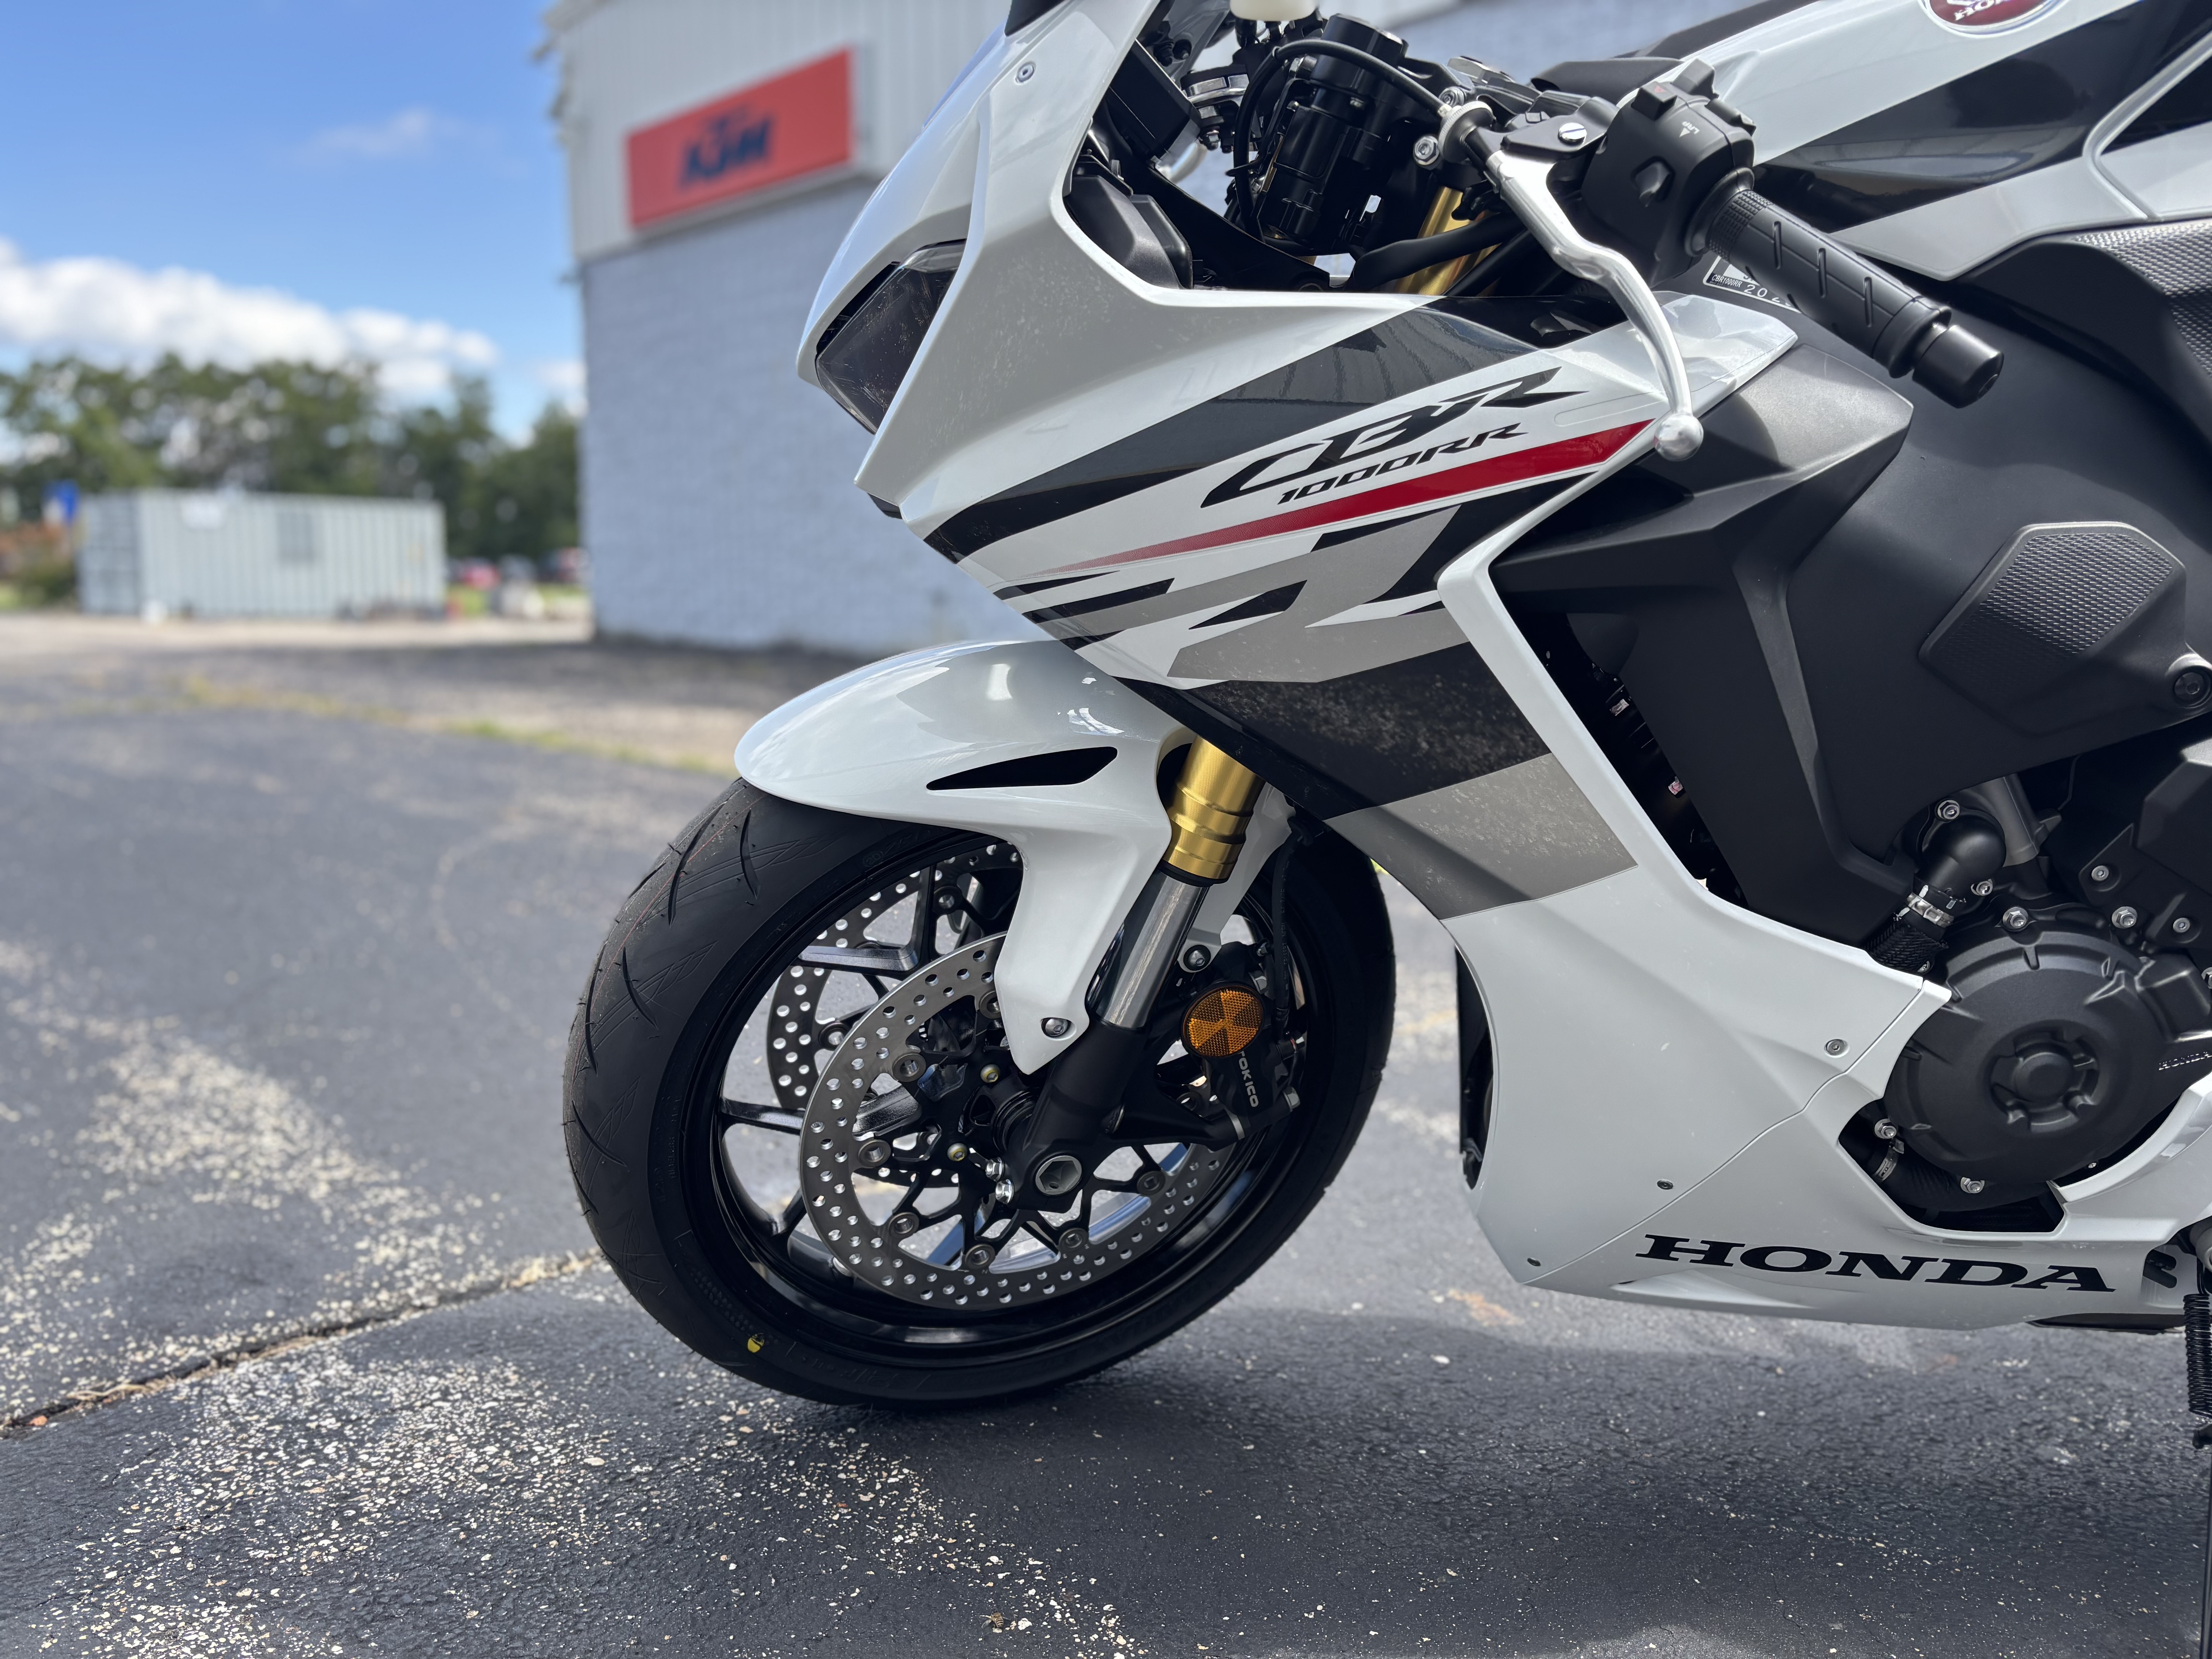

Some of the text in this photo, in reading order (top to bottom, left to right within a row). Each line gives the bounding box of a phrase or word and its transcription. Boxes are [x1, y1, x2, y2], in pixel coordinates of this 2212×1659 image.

[1711, 274, 1743, 288] CBR1000RR
[1200, 366, 1590, 508] CBR
[1277, 422, 1529, 505] 1000RR
[1635, 1234, 2117, 1293] HONDA
